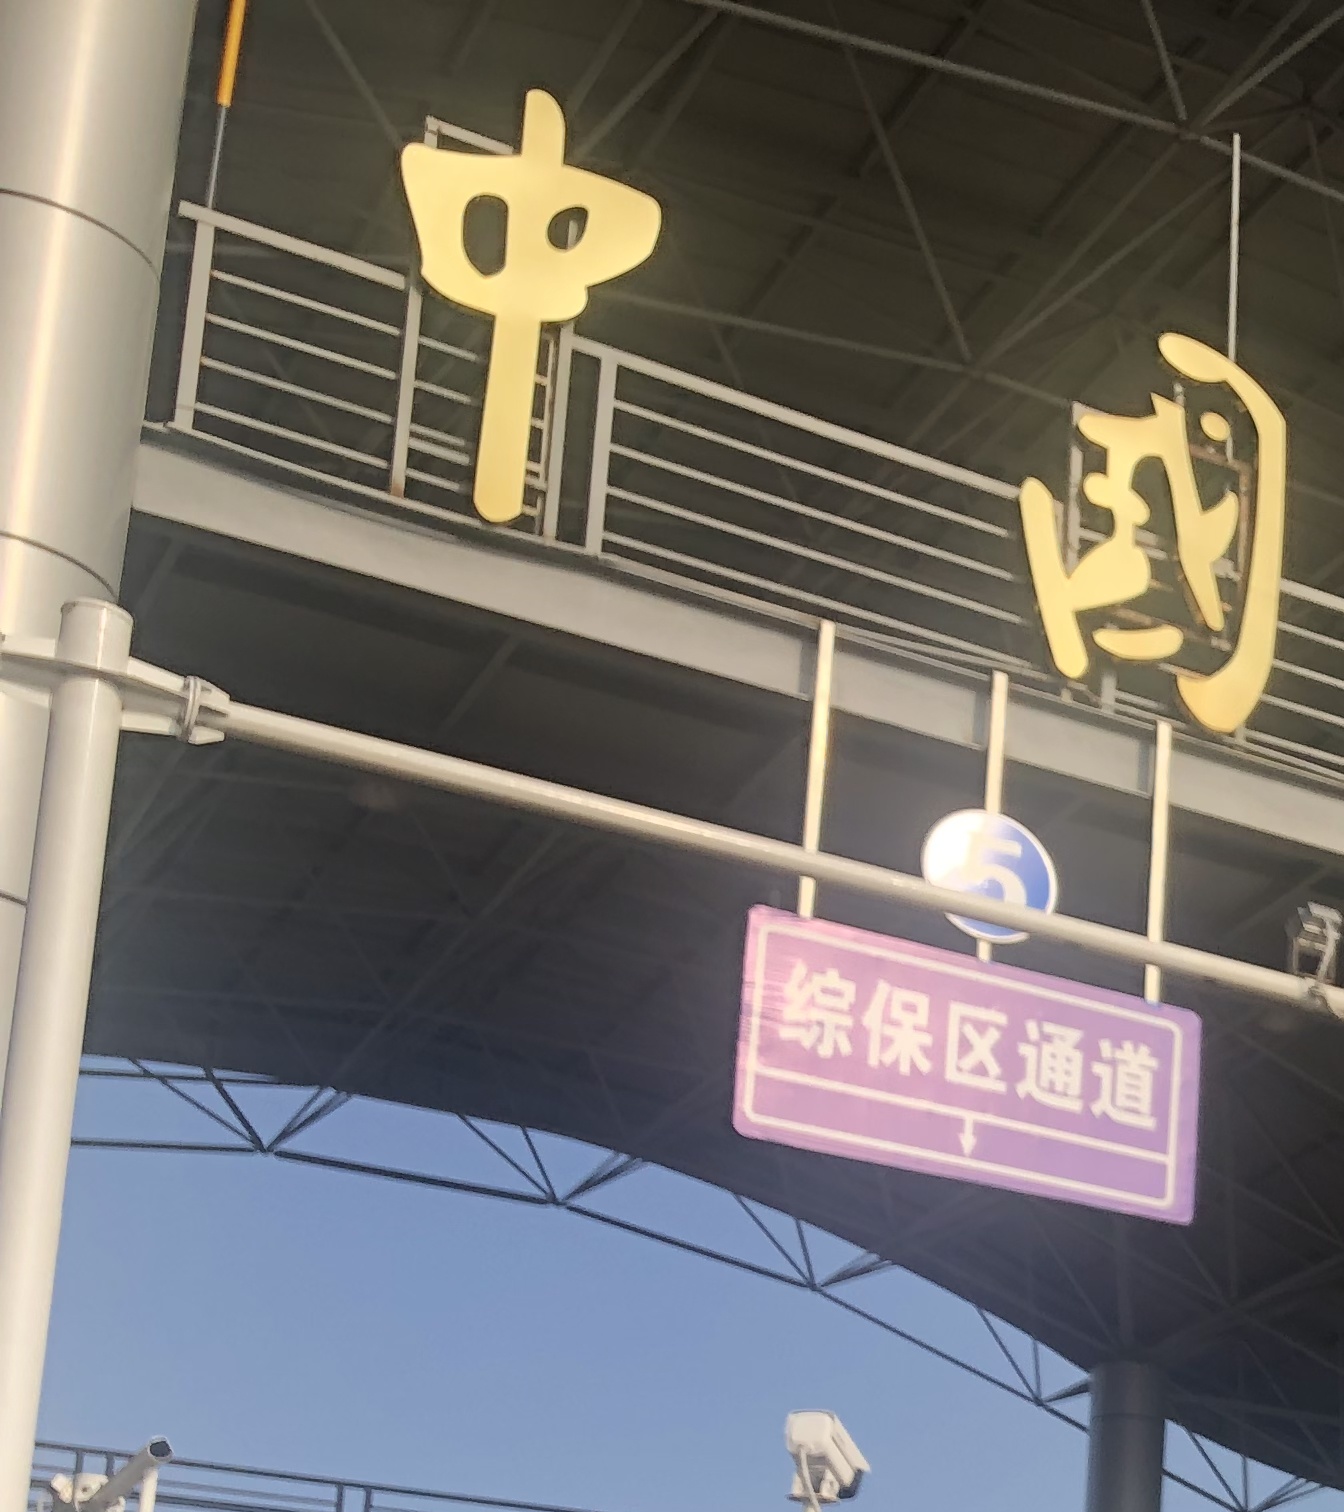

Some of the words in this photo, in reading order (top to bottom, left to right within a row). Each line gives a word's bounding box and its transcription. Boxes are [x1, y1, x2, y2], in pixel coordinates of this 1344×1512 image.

[974, 838, 1027, 907] 5
[779, 960, 1159, 1132] 综保区通道
